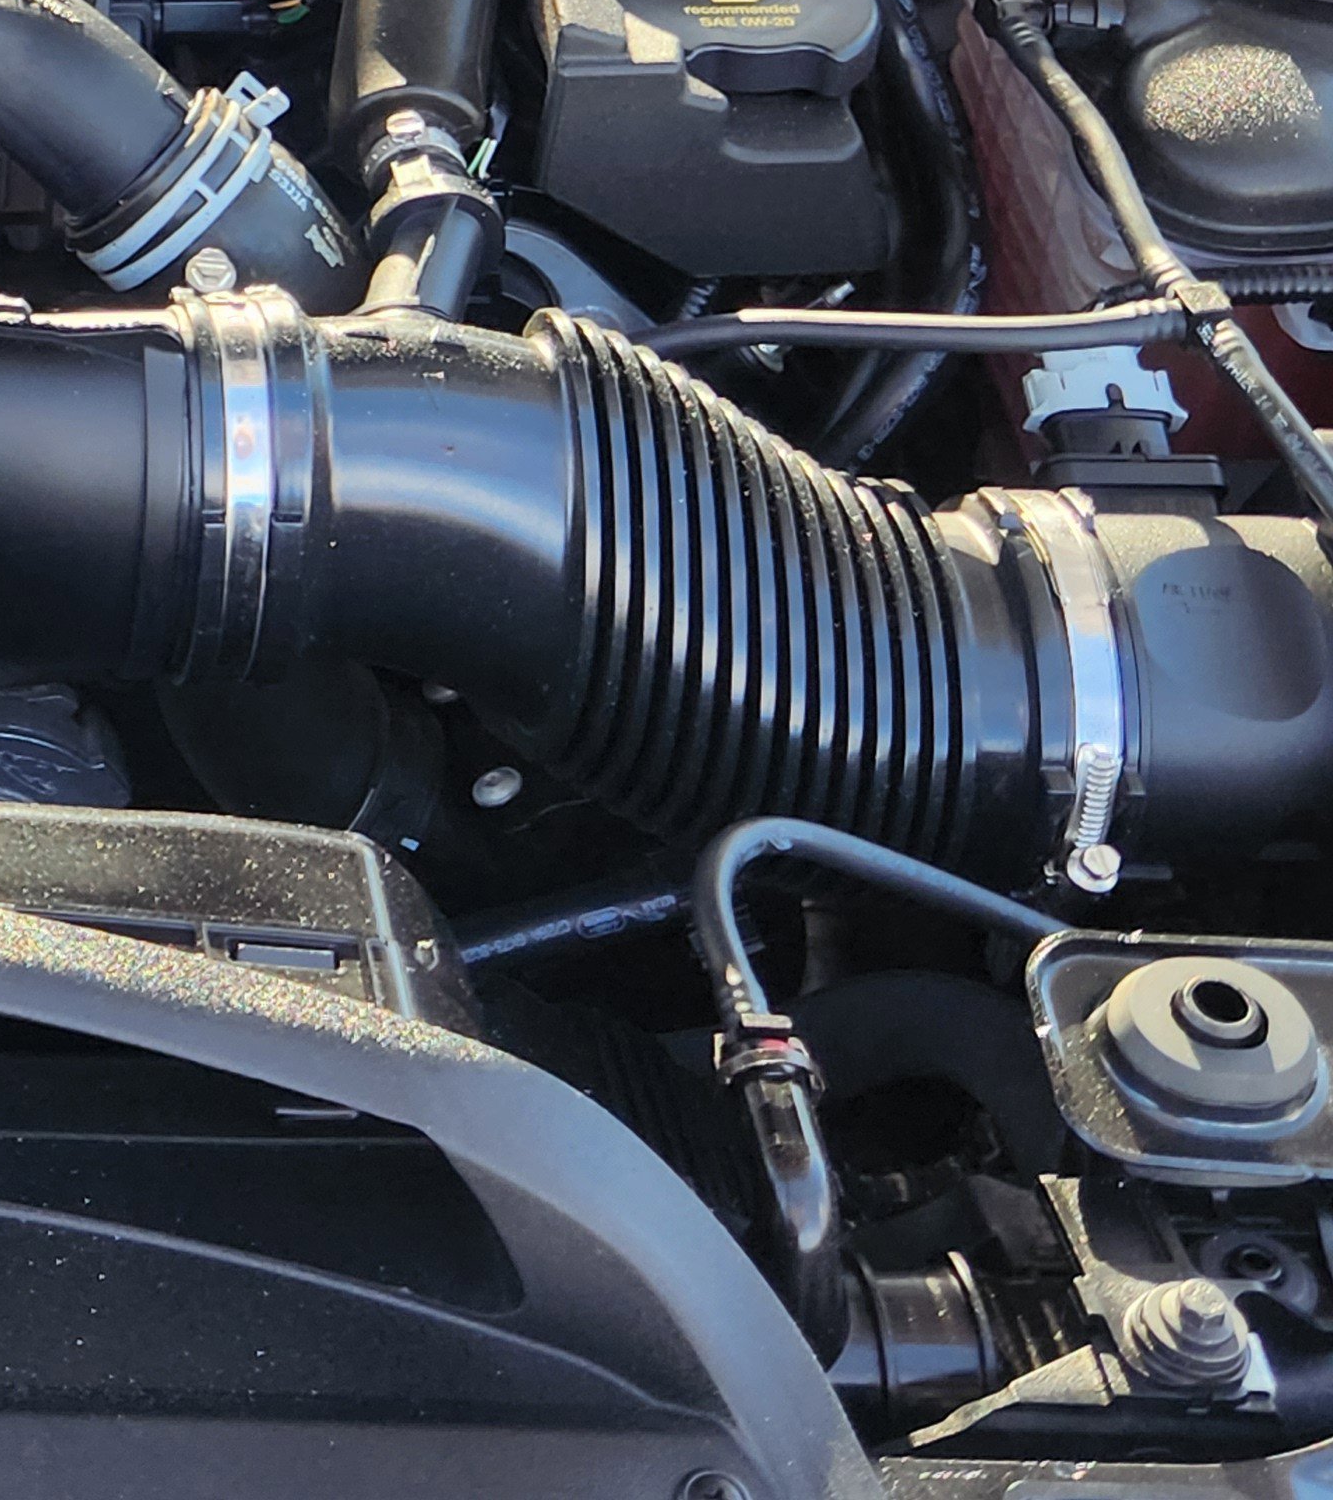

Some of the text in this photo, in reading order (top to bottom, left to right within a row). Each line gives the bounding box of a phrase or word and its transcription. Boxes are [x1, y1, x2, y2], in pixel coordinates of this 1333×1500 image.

[683, 3, 801, 16] recommended
[698, 16, 796, 28] SAE 0W-20
